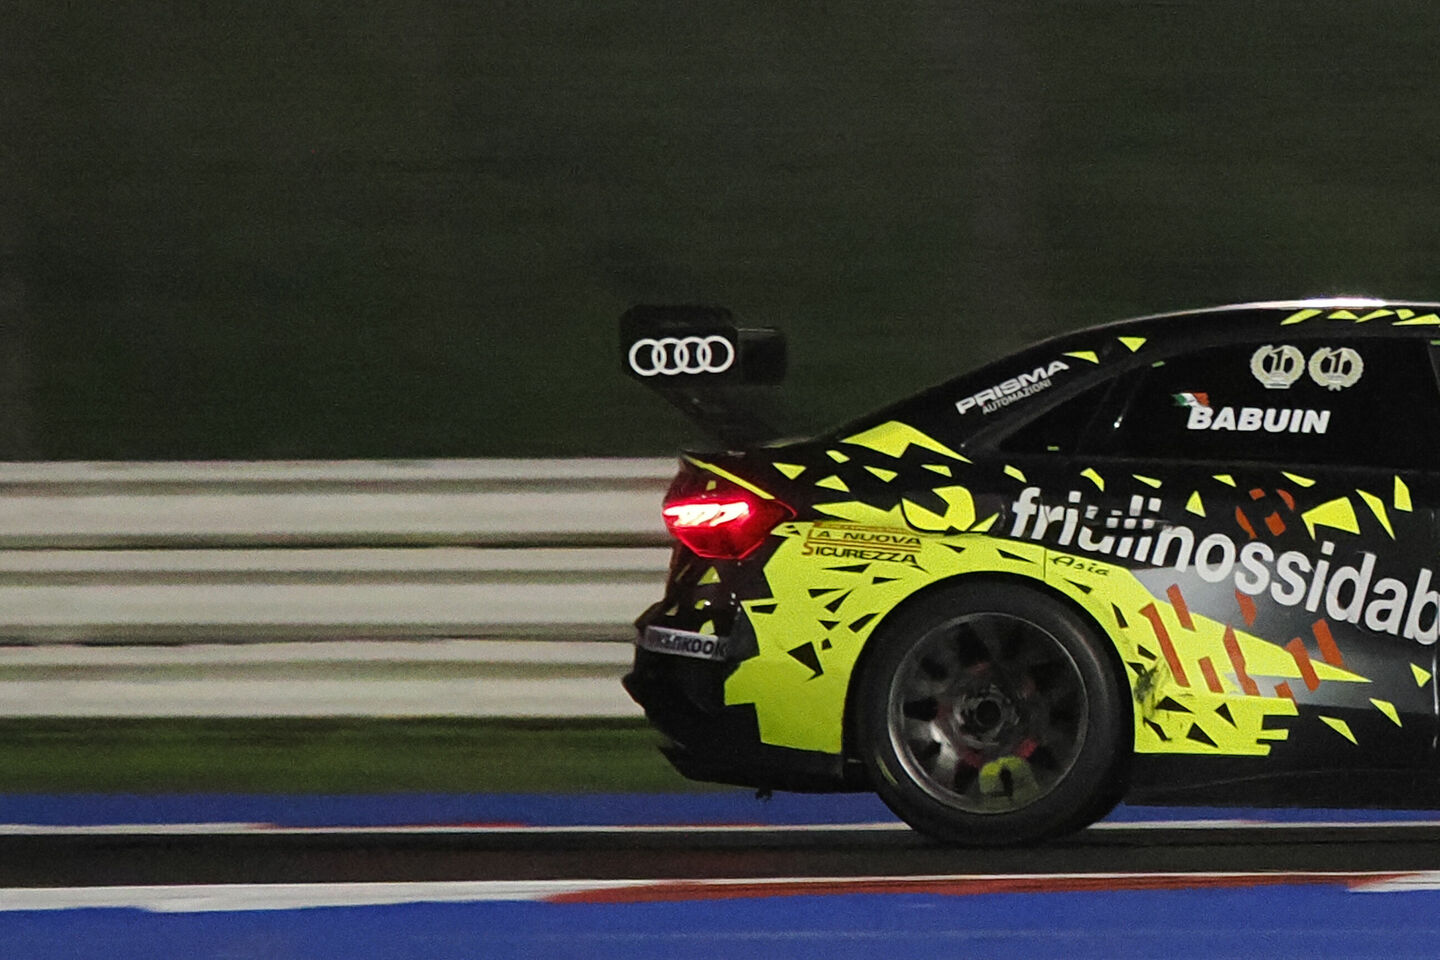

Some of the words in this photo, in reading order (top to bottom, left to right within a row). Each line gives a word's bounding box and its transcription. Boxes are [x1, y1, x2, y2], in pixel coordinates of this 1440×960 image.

[955, 360, 1070, 415] PRISMA
[982, 378, 1052, 415] AUTOMAZIONI
[1187, 406, 1331, 434] BABUIN
[843, 531, 921, 545] NUOVA
[801, 542, 918, 565] SICUREZZA
[1048, 555, 1109, 576] Asia
